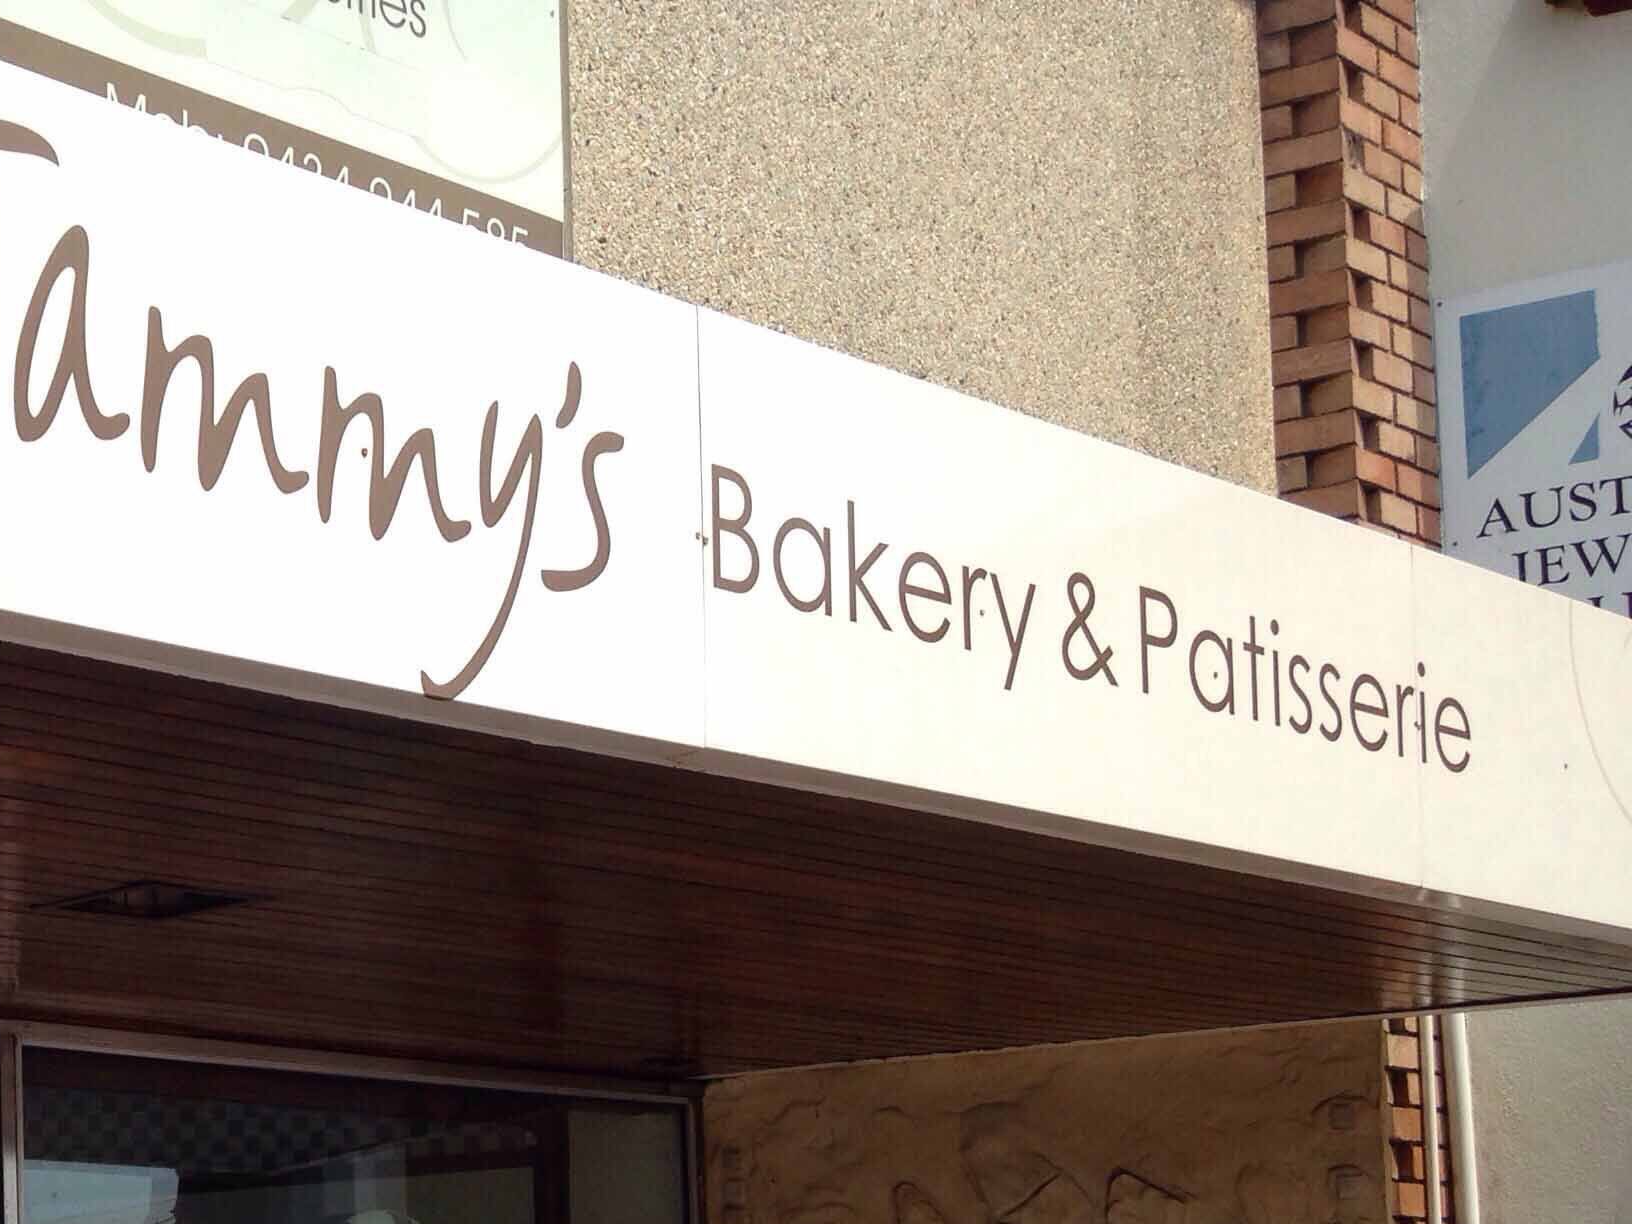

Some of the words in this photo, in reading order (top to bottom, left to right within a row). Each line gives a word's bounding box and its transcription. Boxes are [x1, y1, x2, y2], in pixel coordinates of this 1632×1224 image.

[1476, 475, 1632, 538] AUST
[710, 463, 1037, 692] Bakery
[1061, 571, 1119, 689] &
[1138, 585, 1472, 773] Patisserie
